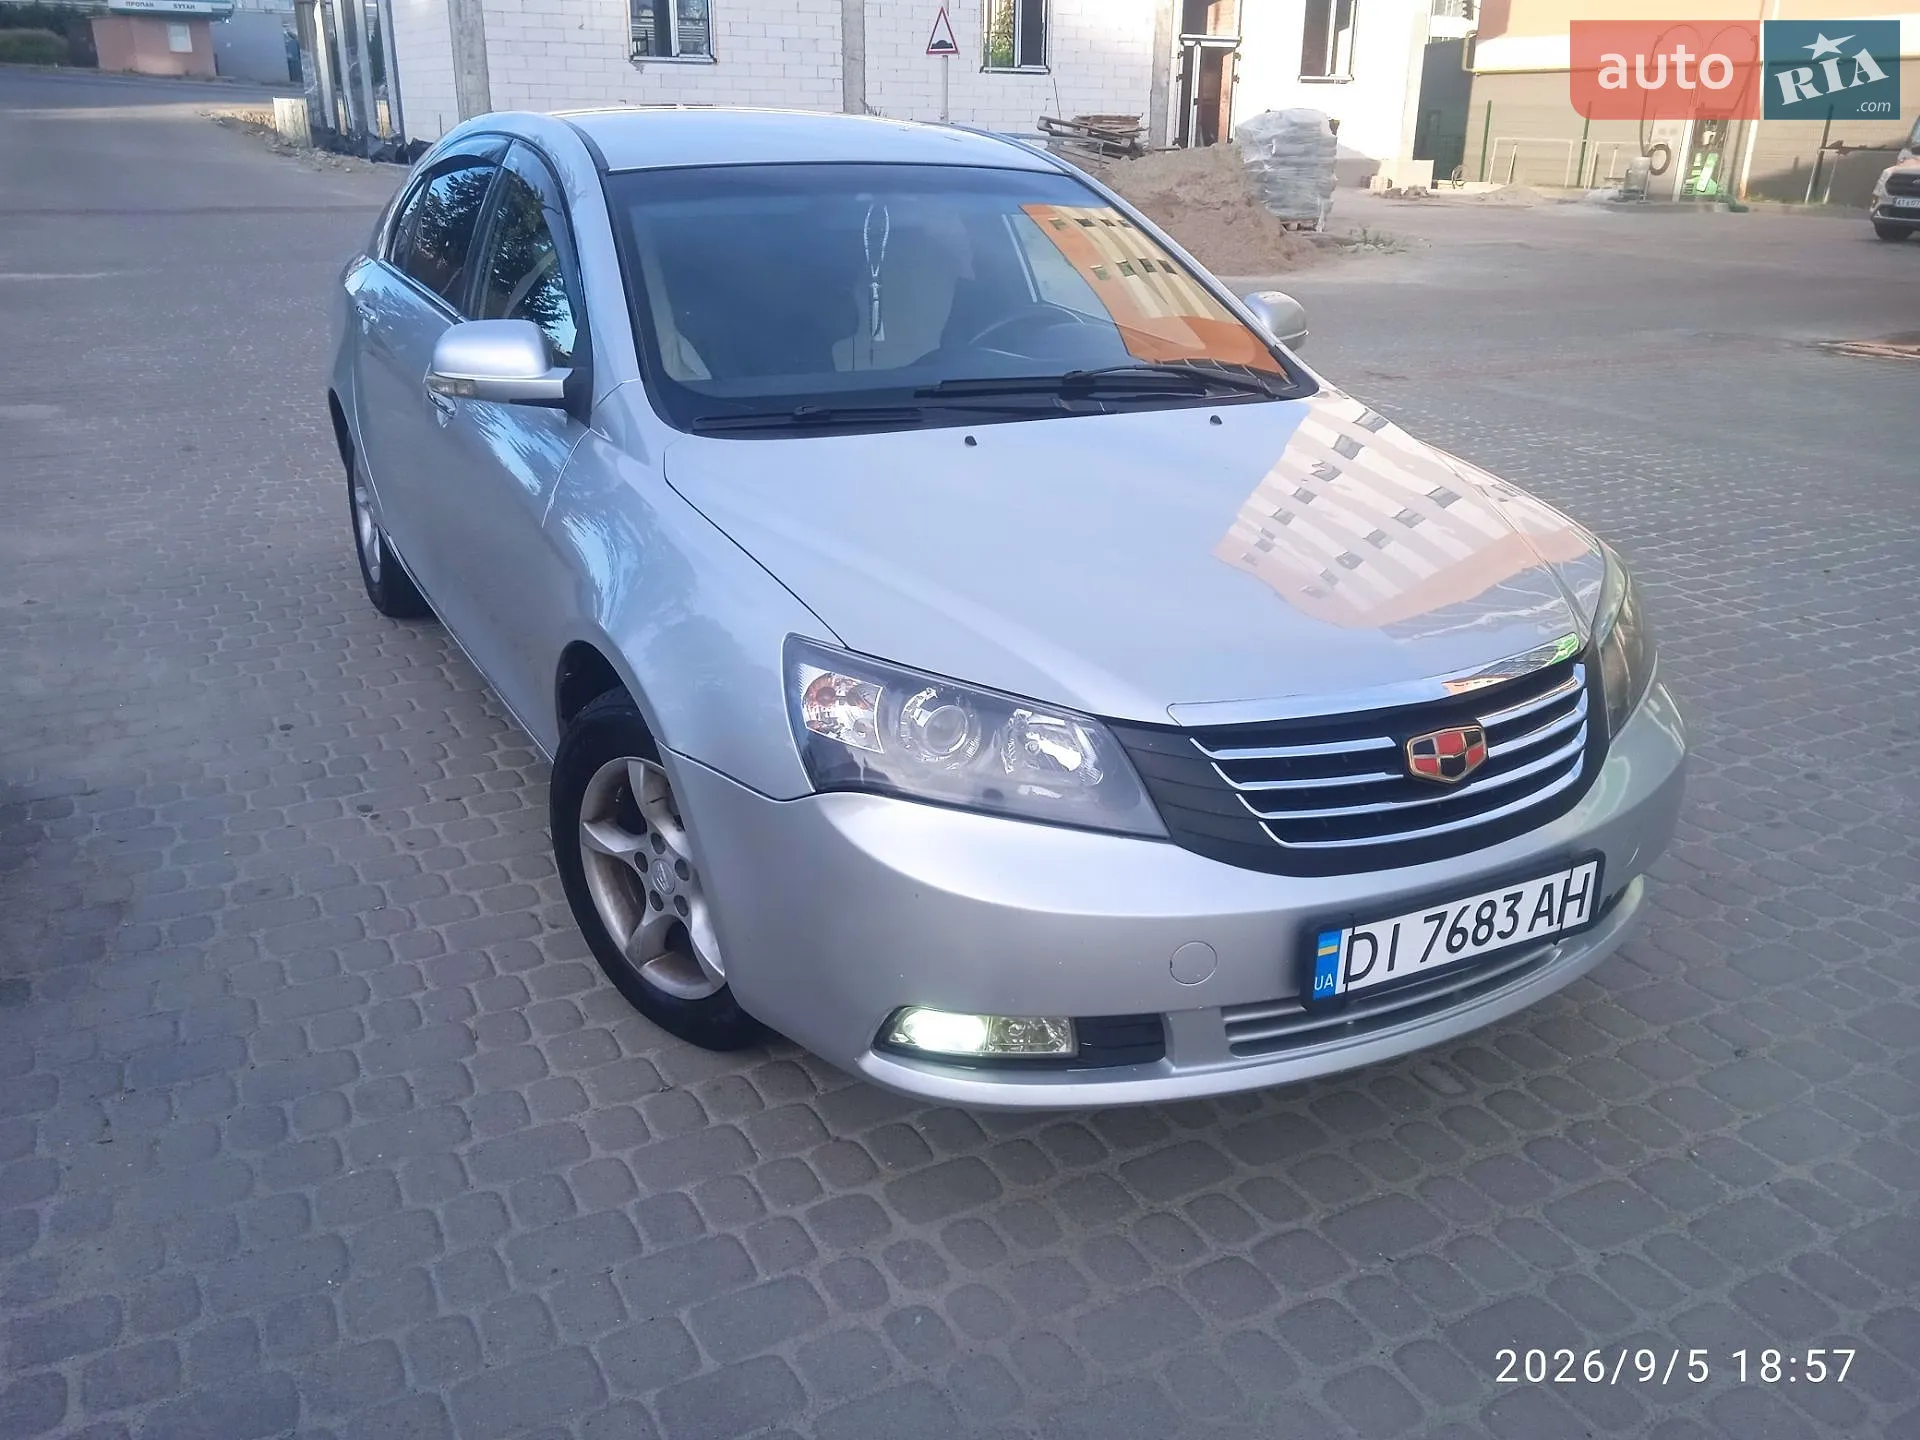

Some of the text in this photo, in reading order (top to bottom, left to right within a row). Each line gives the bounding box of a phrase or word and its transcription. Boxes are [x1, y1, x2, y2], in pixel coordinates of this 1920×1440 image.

[173, 2, 195, 10] БУТАН
[1343, 872, 1591, 985] DI 7683 AH
[1314, 973, 1334, 991] UA
